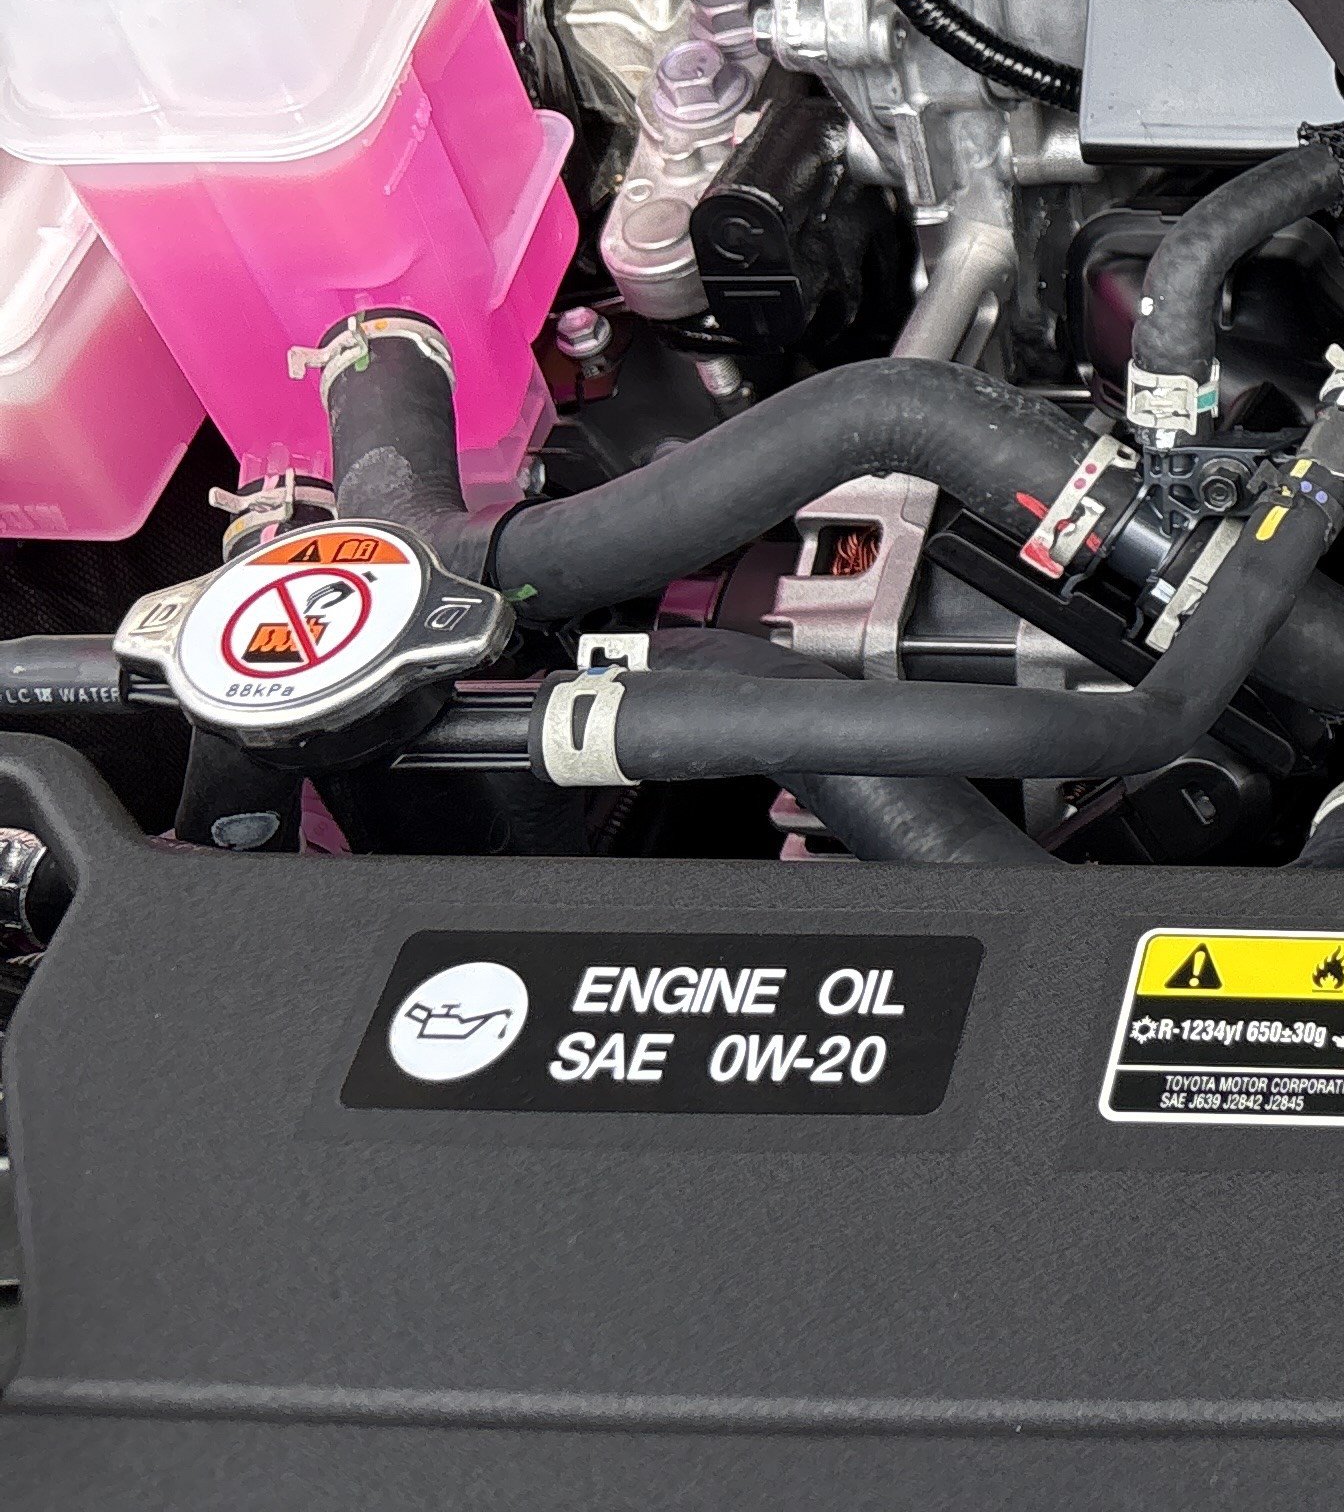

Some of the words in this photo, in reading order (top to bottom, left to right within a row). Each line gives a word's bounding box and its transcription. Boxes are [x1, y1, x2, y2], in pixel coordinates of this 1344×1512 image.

[59, 687, 120, 704] WATER
[225, 683, 296, 697] 88kPa
[572, 966, 788, 1015] ENGINE
[818, 968, 905, 1016] OIL
[1157, 1019, 1243, 1045] R-1234yf
[1246, 1022, 1327, 1048] 650±30g
[548, 1031, 675, 1081] SAE
[709, 1034, 888, 1084] 0W-20
[1164, 1075, 1216, 1092] TOYOTA
[1218, 1076, 1268, 1093] MOTOR
[1159, 1092, 1188, 1109] SAE
[1188, 1093, 1222, 1110] J639
[1222, 1094, 1263, 1111] J2842
[1264, 1095, 1305, 1112] J2845
